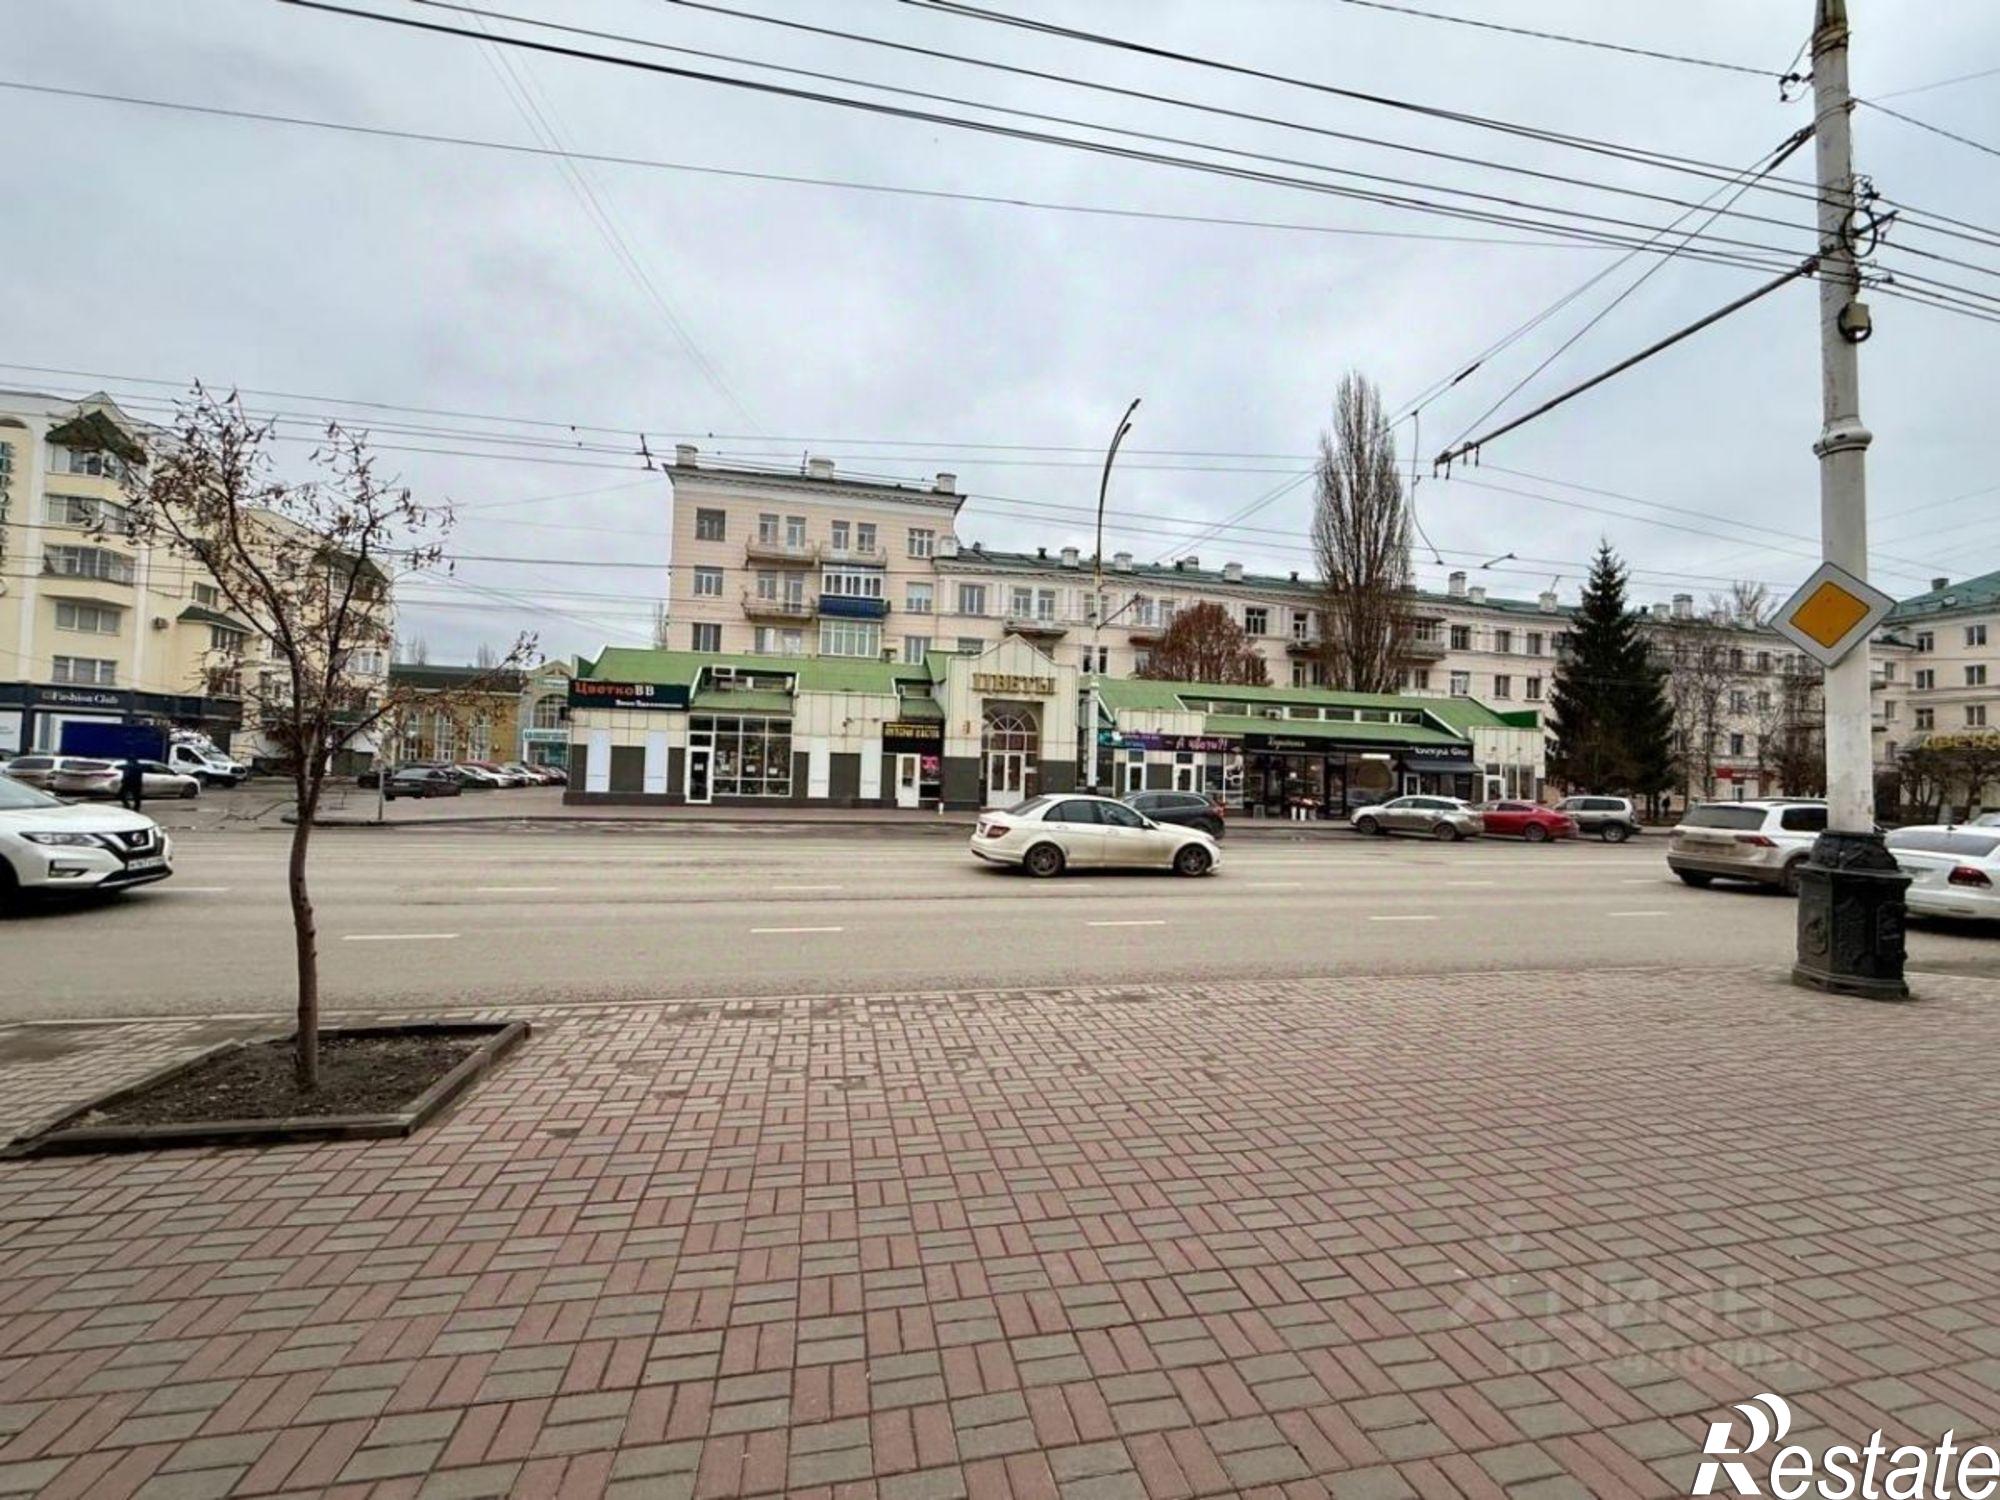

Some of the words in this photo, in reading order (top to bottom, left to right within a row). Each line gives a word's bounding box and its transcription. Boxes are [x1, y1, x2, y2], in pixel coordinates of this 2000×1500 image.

[574, 682, 655, 697] ЦветкоВВ
[972, 673, 1056, 696] ЦВЕТЫ
[52, 691, 93, 704] Fashion
[94, 694, 119, 704] Club
